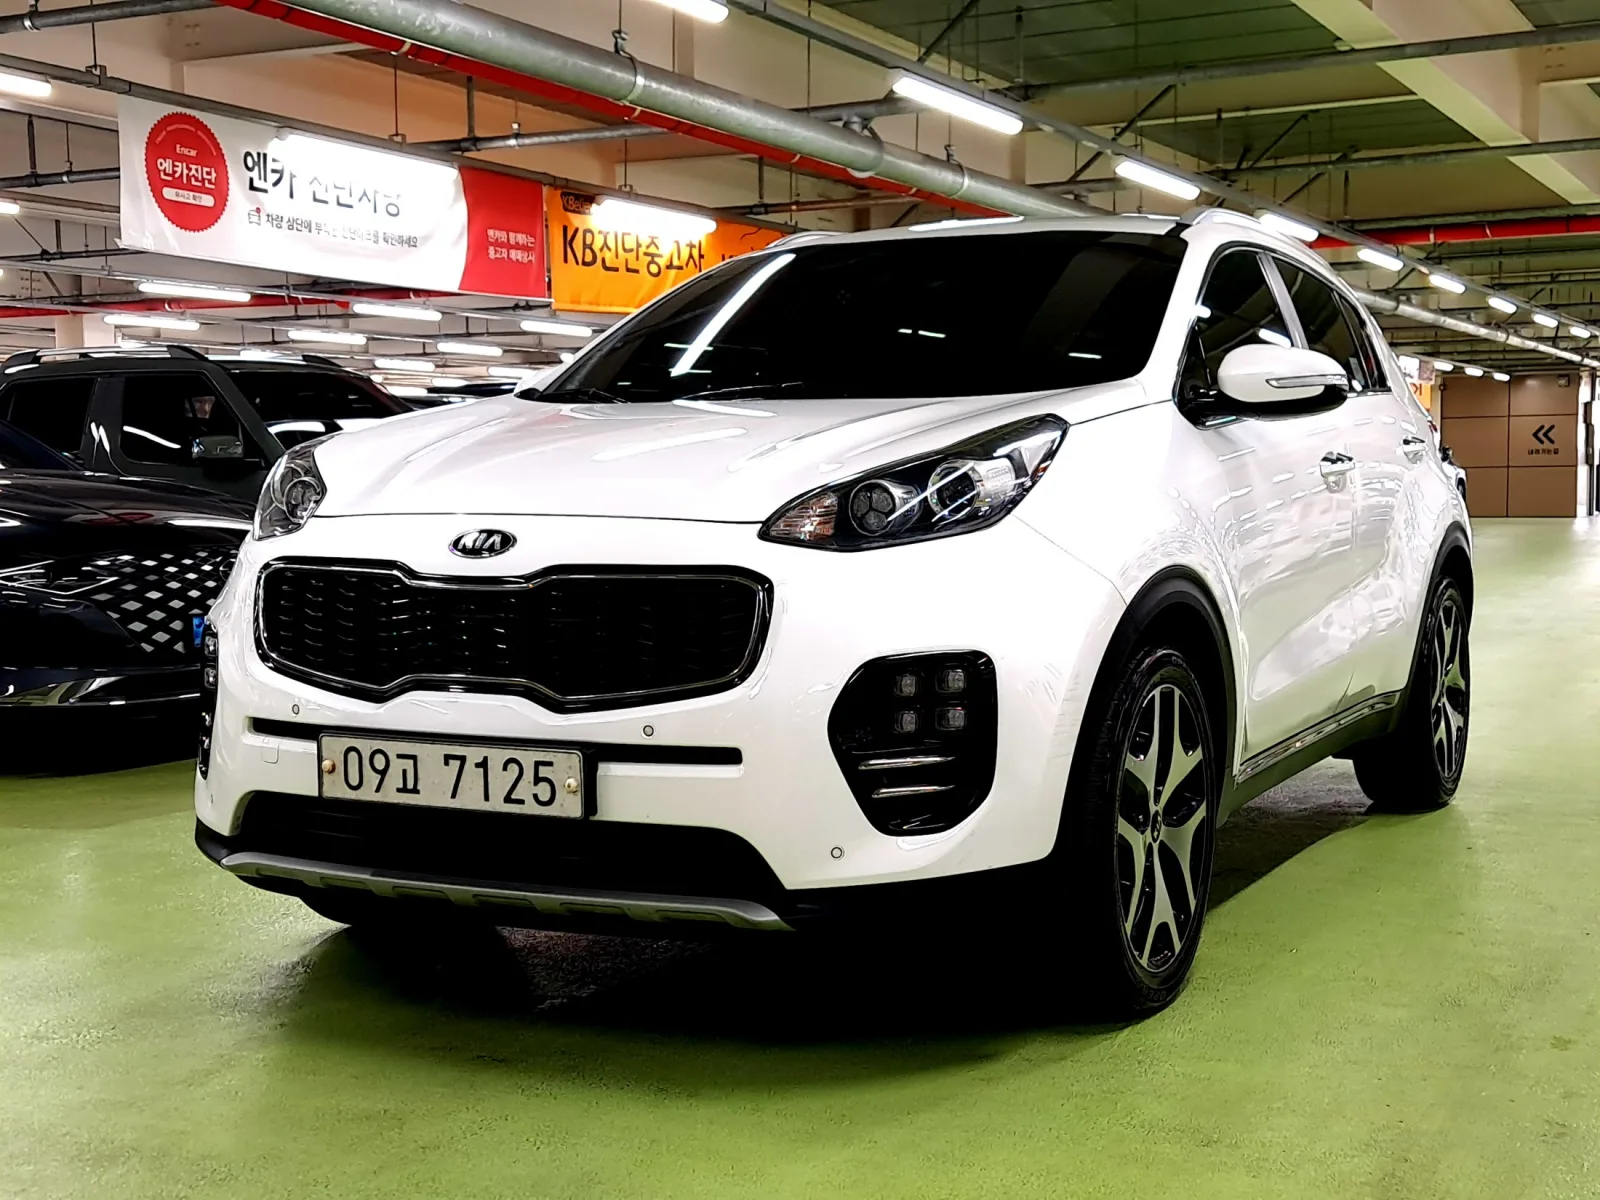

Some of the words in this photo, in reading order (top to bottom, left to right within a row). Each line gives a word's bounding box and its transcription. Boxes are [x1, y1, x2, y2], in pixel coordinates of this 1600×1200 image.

[175, 144, 198, 157] Encar
[156, 158, 217, 189] 엔카진단
[243, 150, 297, 199] 엔카
[265, 212, 284, 229] 차량
[285, 216, 312, 233] 상단에
[562, 225, 704, 277] KB진단중고차
[457, 532, 502, 550] KIA
[342, 745, 420, 795] 09고
[443, 753, 557, 807] 7125
